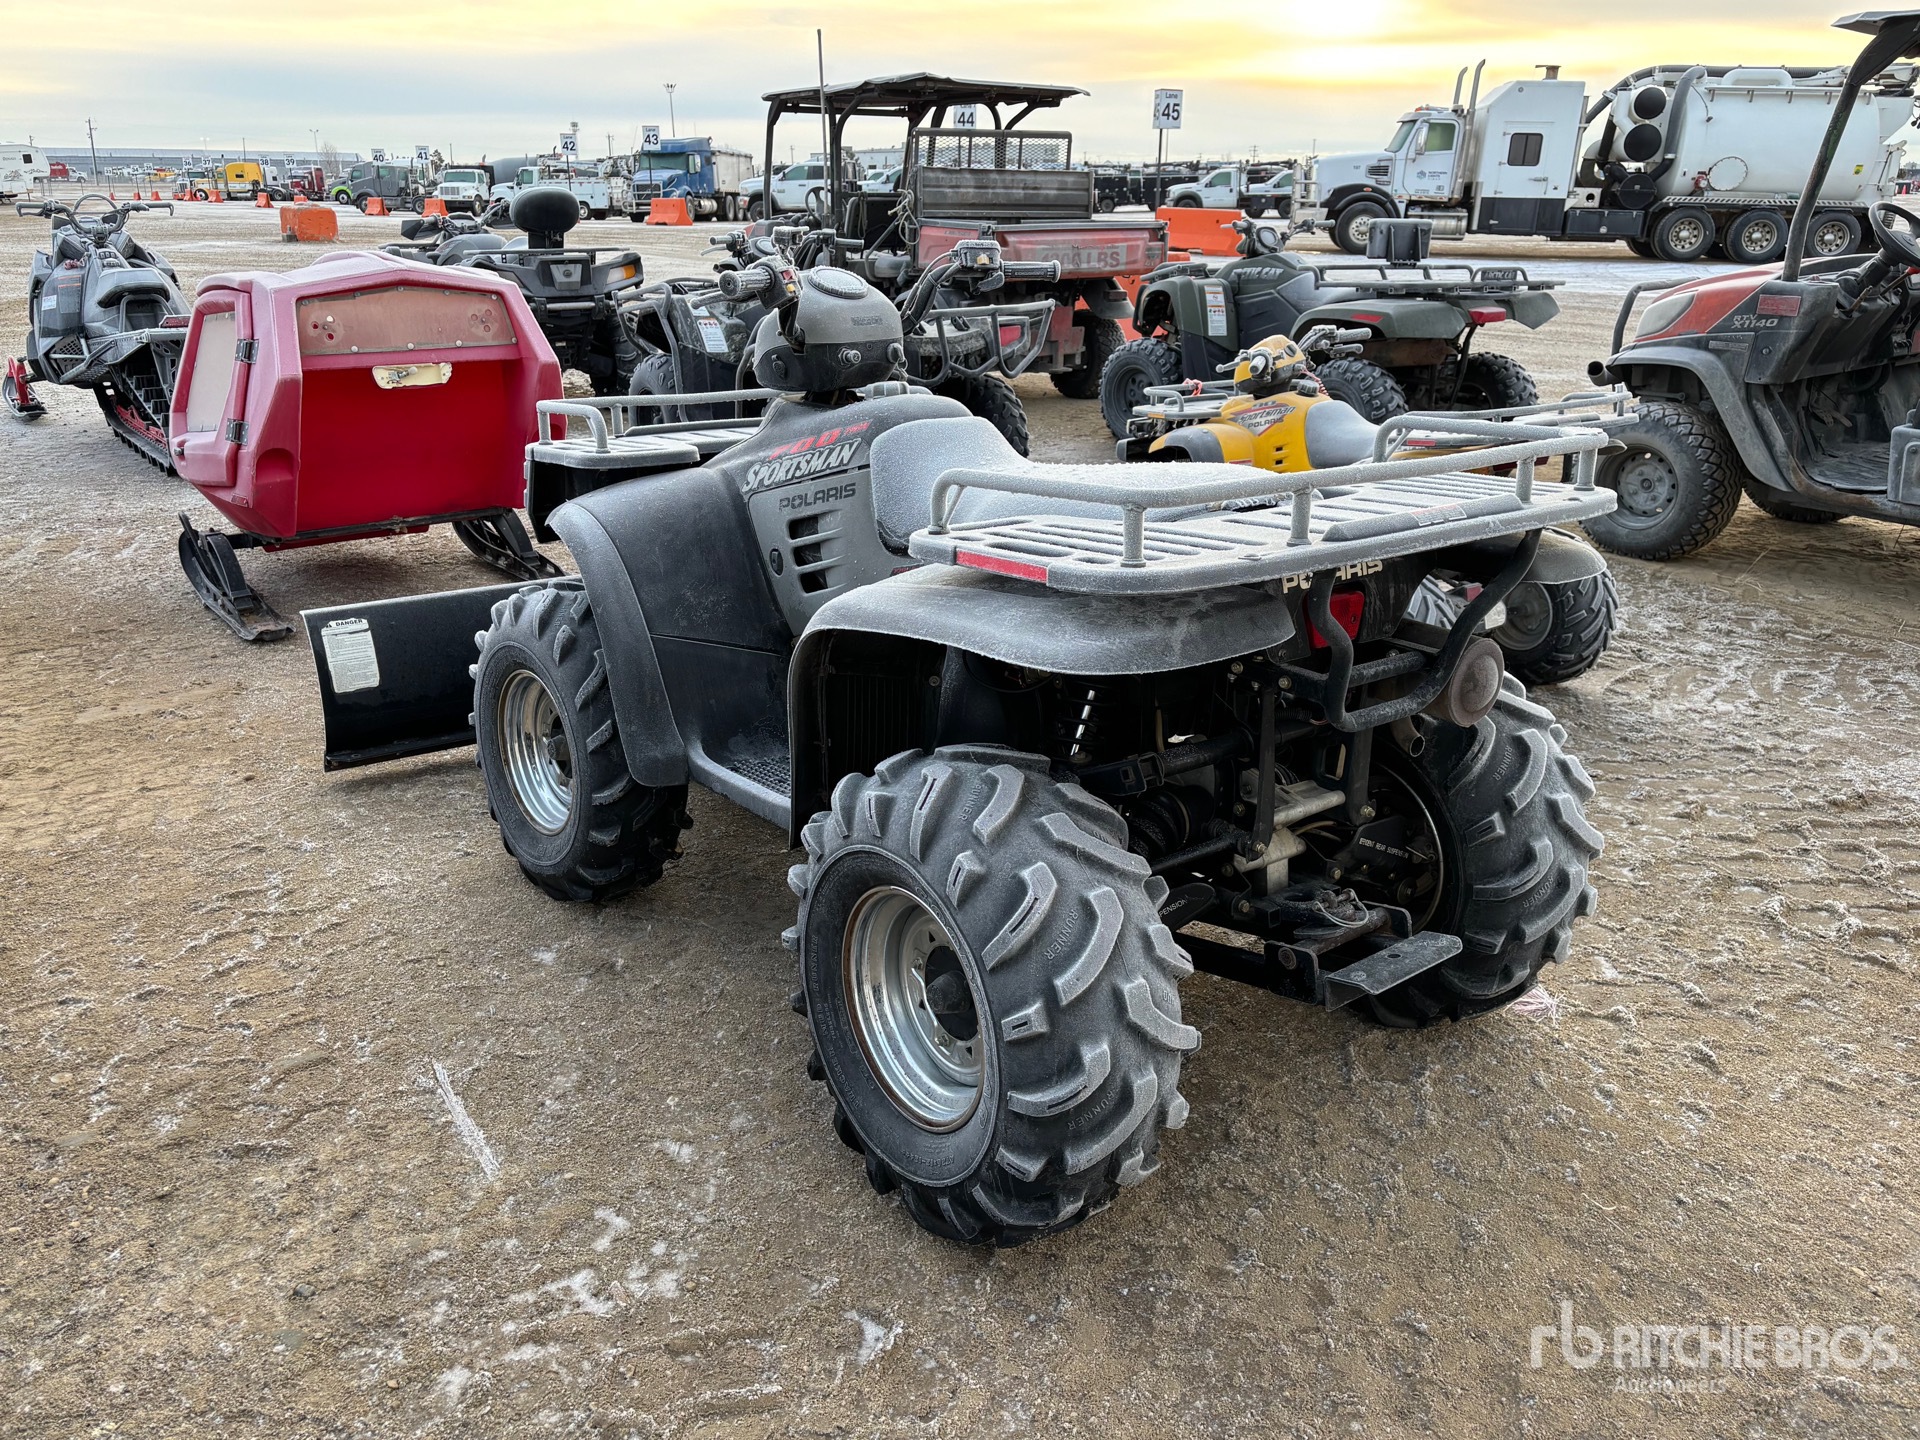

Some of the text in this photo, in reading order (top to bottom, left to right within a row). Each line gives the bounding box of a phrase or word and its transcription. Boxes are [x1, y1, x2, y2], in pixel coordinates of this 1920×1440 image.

[957, 111, 975, 127] 44
[1161, 102, 1180, 121] 45
[562, 141, 576, 151] 42
[644, 133, 659, 145] 43
[373, 154, 384, 162] 40
[417, 152, 428, 160] 41
[1261, 267, 1285, 280] CAT
[1731, 319, 1779, 328] X1140
[1238, 406, 1297, 424] Sportsman
[1247, 417, 1285, 428] POLARIS
[767, 428, 843, 461] 700
[741, 438, 861, 494] SPORTSMAN
[779, 483, 856, 511] POLARIS
[1281, 560, 1384, 594] POARIS
[335, 619, 363, 627] DANGER
[1492, 745, 1512, 782] RUNNER
[958, 784, 981, 821] RUNNER
[1522, 876, 1554, 908] RUNNER
[1044, 909, 1079, 960] RUNNER
[1067, 1090, 1115, 1130] RUNNER
